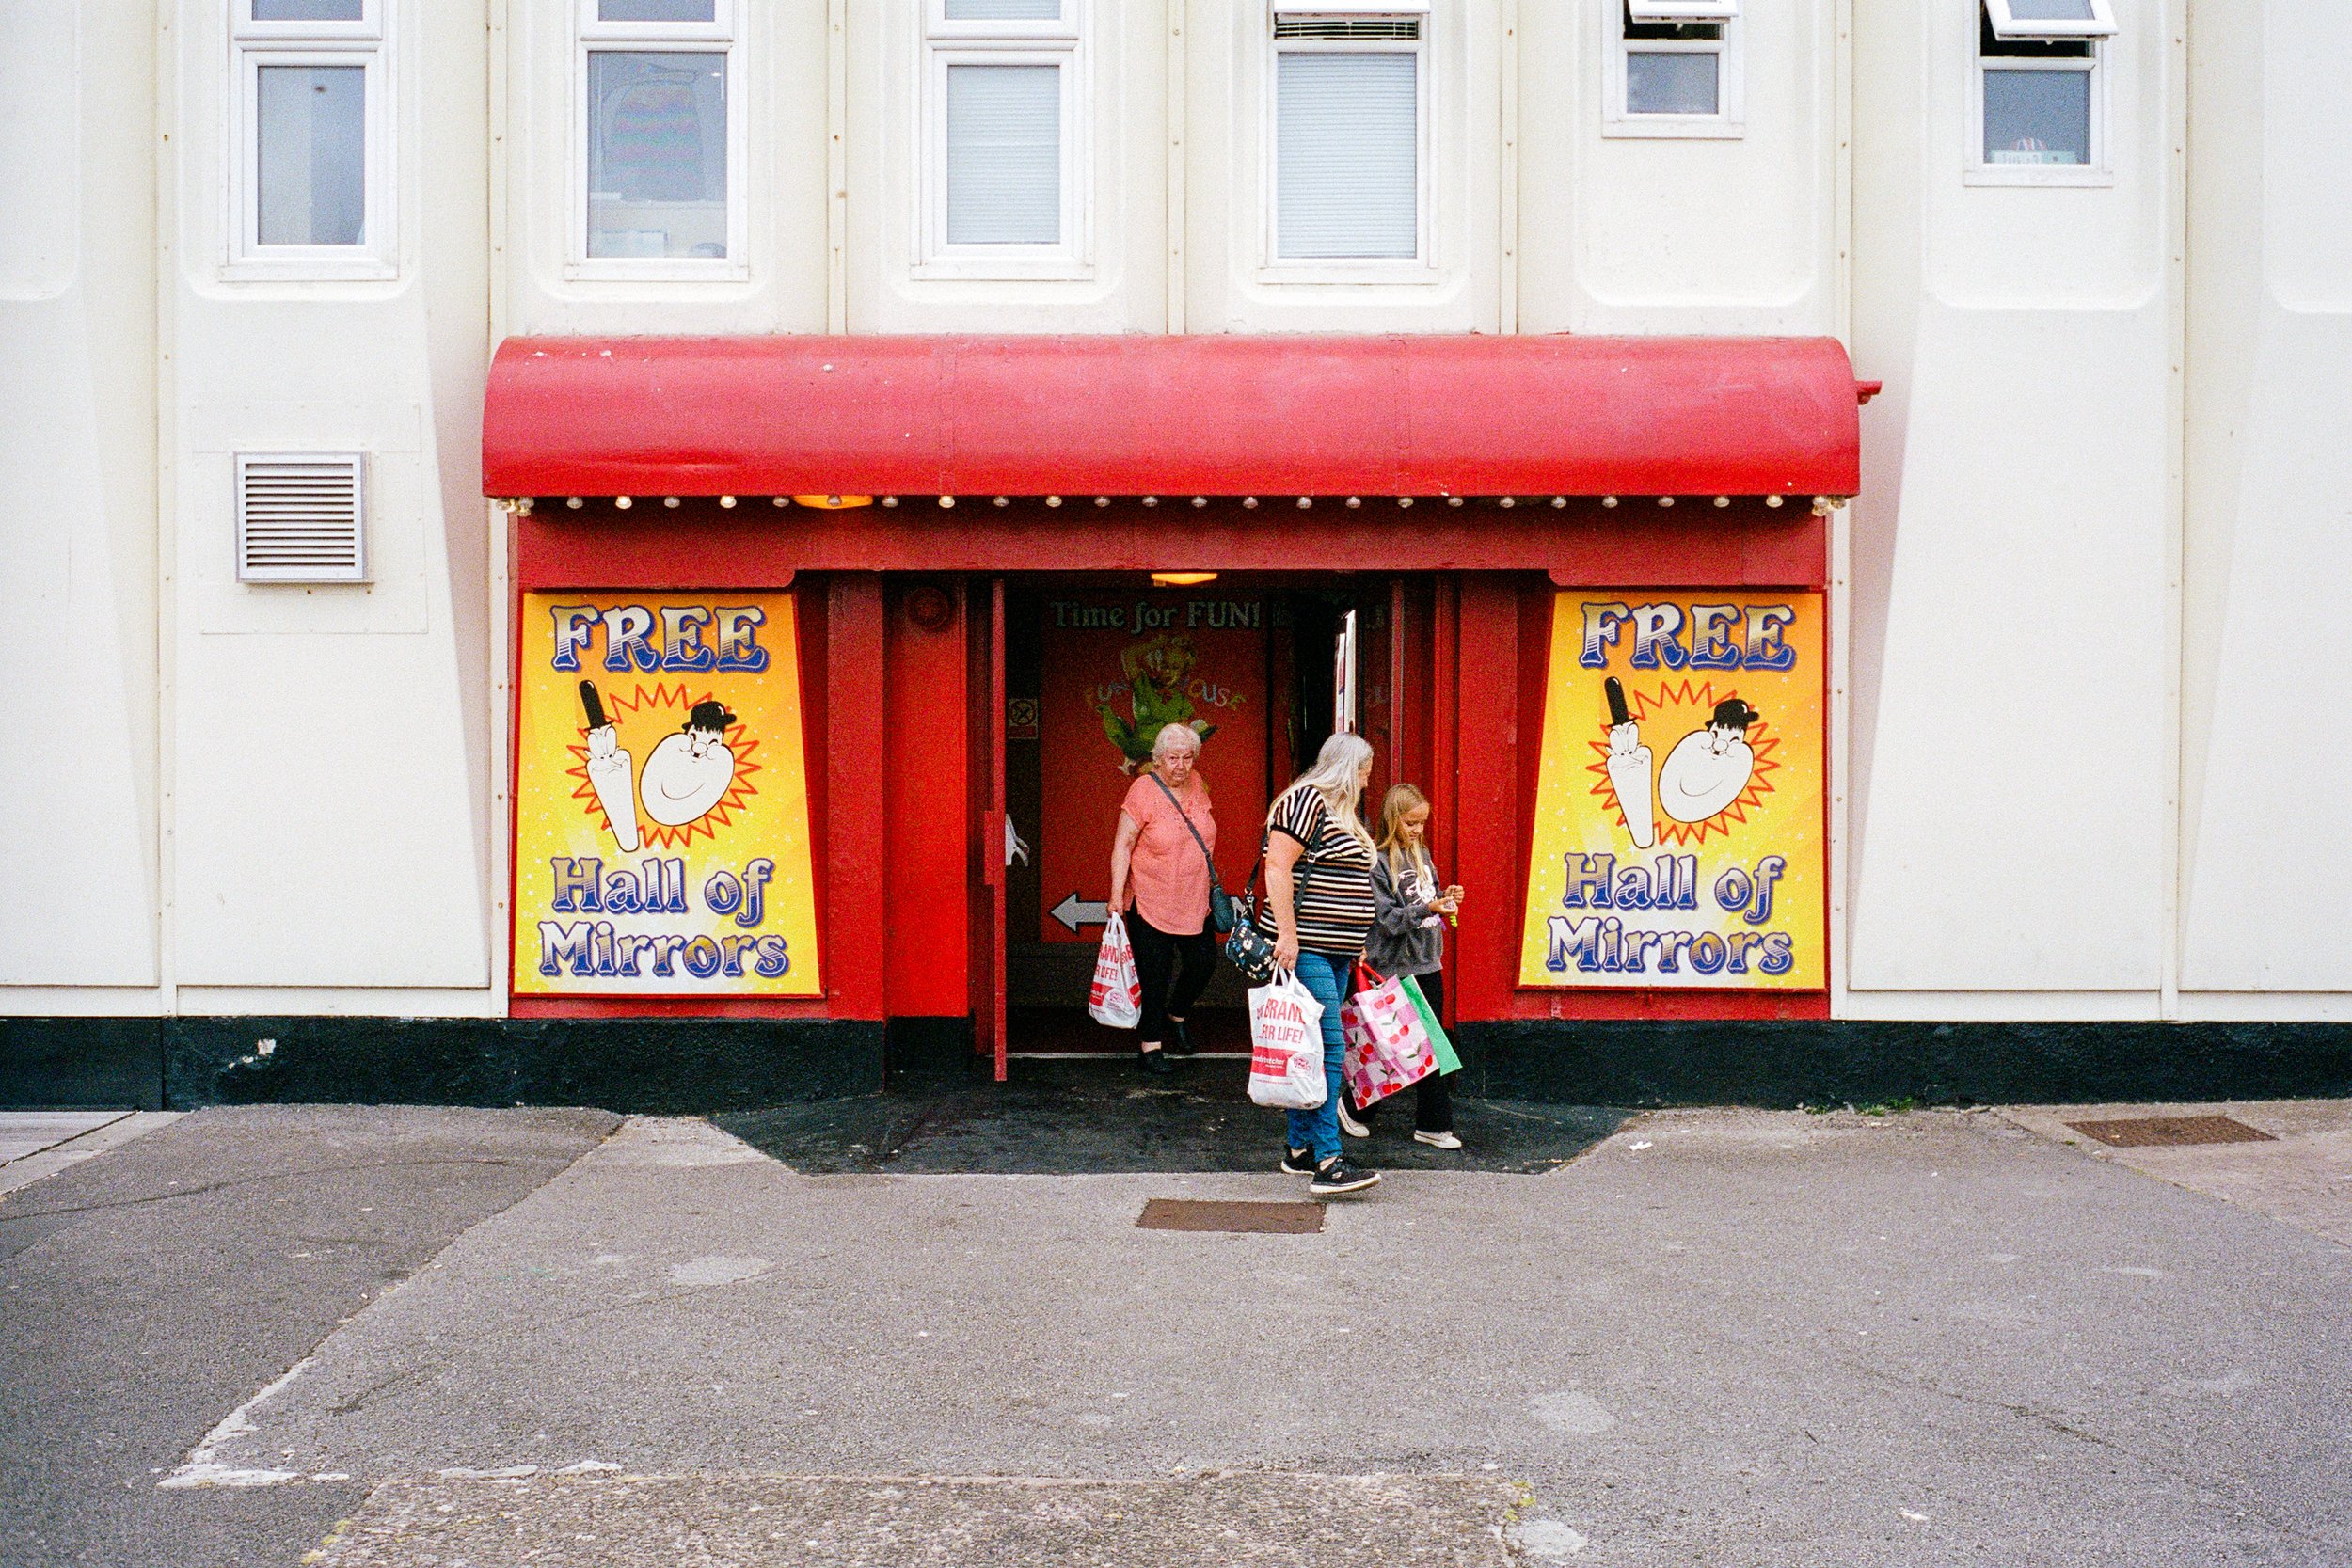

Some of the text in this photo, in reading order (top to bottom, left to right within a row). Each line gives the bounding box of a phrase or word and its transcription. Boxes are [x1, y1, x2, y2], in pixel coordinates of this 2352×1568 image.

[549, 604, 771, 673] FREE
[1050, 600, 1125, 628] Time
[1130, 600, 1179, 636] for
[1185, 600, 1262, 629] FUN!
[1579, 601, 1797, 672] FREE
[550, 856, 775, 928] Hall of
[1563, 852, 1787, 925] Hall of
[538, 920, 791, 978] Mirrors
[1546, 916, 1794, 975] Mirrors
[1278, 1026, 1304, 1044] LIFE!
